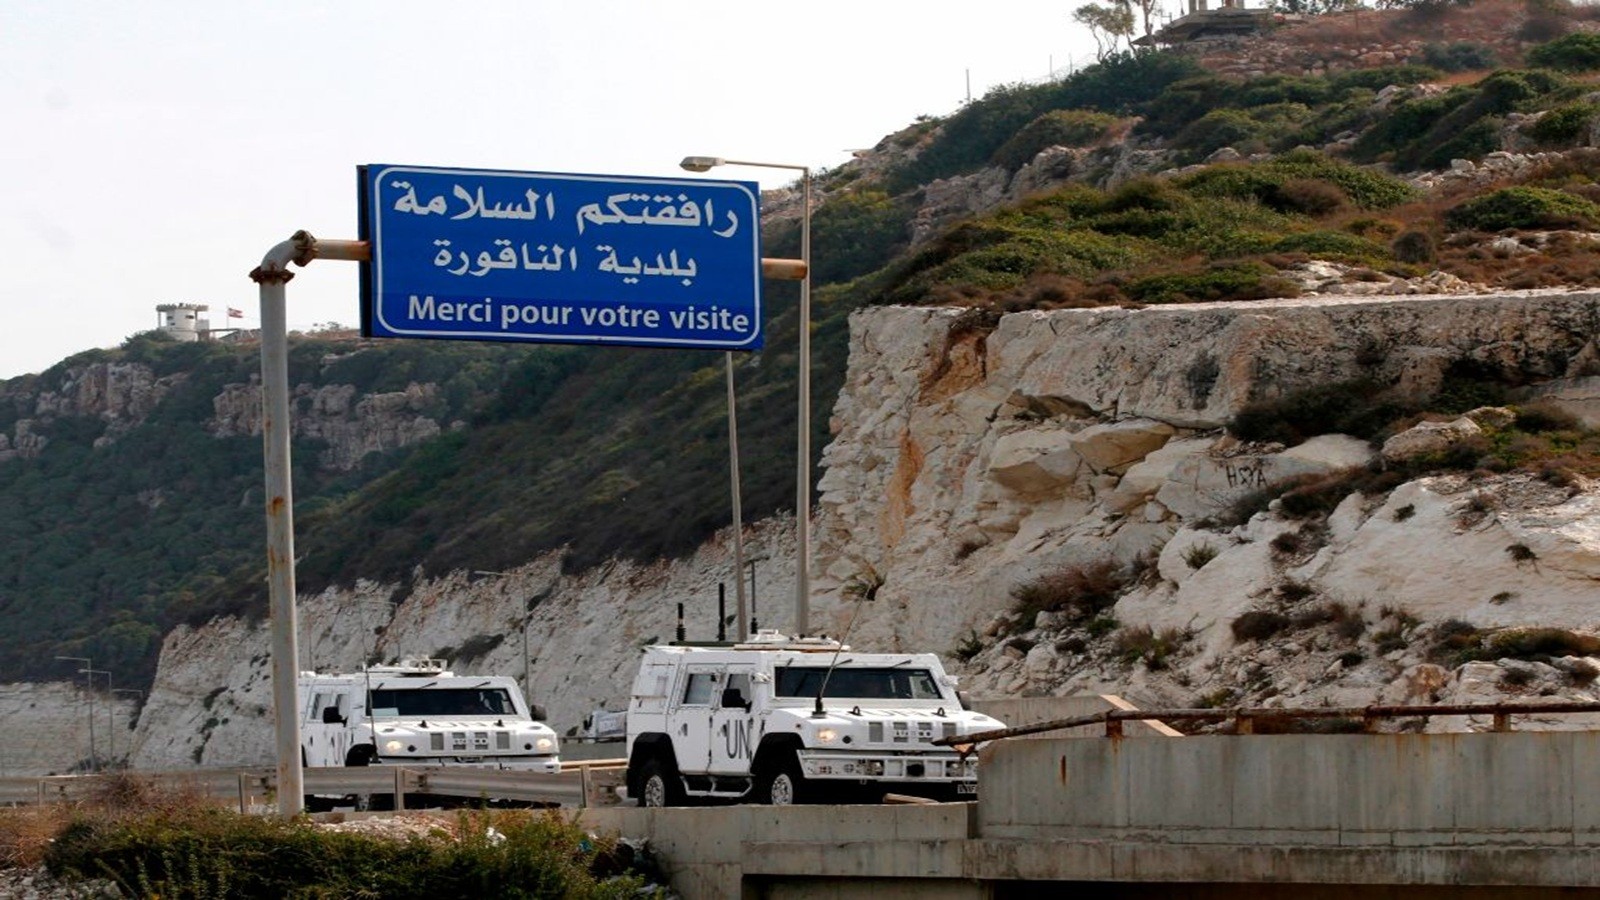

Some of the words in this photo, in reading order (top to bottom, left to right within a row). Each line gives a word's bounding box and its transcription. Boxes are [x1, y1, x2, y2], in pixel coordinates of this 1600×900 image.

[390, 180, 555, 221] السلامة
[576, 192, 738, 238] رافقتكم
[432, 238, 578, 277] الناقورة
[596, 244, 698, 286] بلدية
[408, 294, 492, 322] Merci
[501, 304, 573, 329] pour
[580, 305, 660, 328] votre
[669, 305, 750, 333] visite
[726, 719, 751, 760] UN
